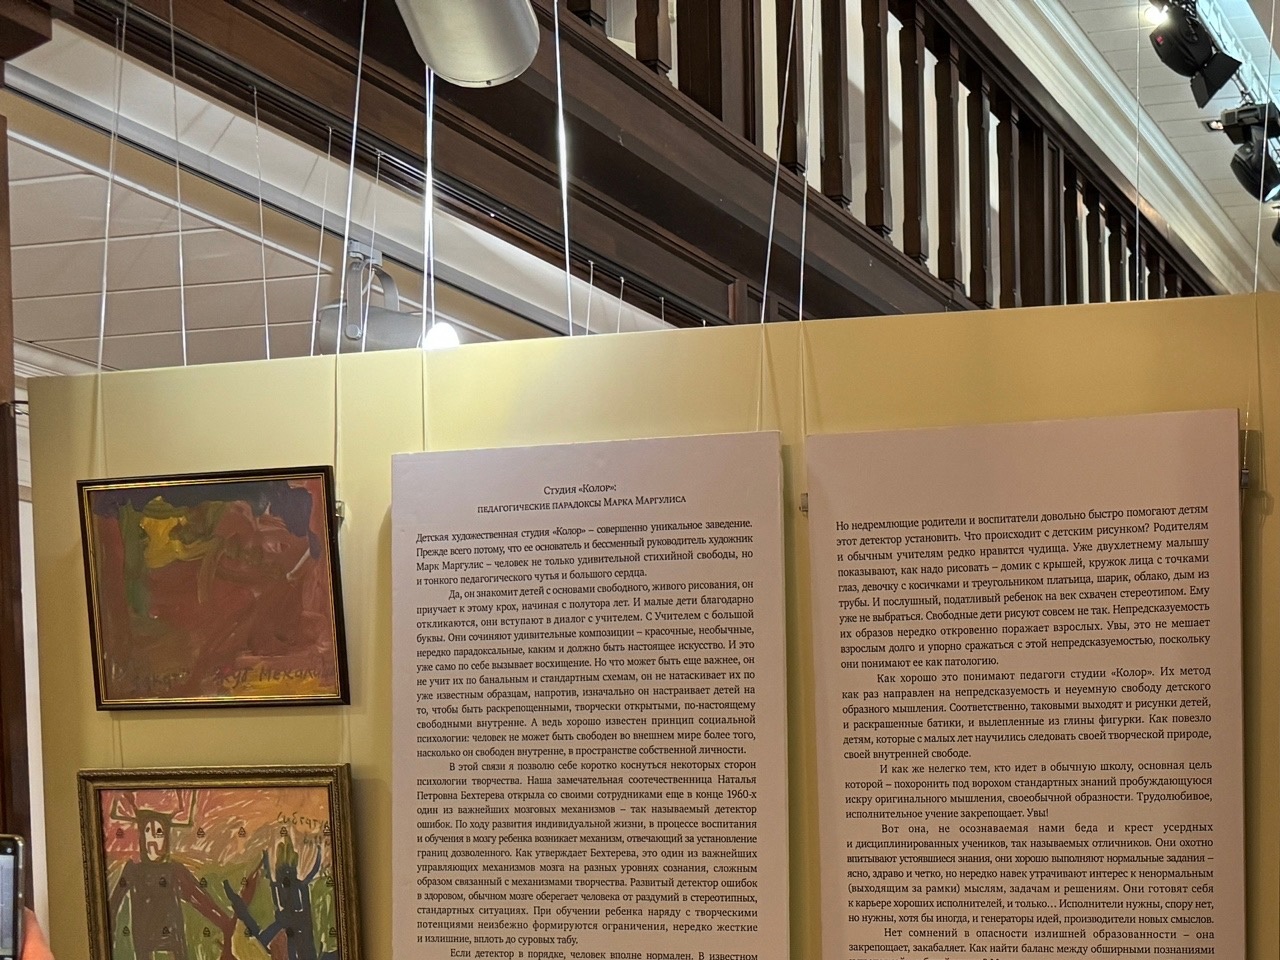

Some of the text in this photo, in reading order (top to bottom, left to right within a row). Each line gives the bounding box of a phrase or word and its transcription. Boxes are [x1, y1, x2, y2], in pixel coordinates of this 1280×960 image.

[835, 521, 850, 530] Но
[851, 520, 920, 532] недремлющие
[921, 518, 967, 529] родители
[977, 515, 1039, 524] воспитатели
[1040, 512, 1087, 523] довольно
[1088, 509, 1125, 520] быстро
[1126, 508, 1177, 517] помогают
[1177, 506, 1209, 516] детям
[415, 534, 449, 544] Детская
[451, 531, 519, 543] художественная
[520, 530, 550, 539] студия
[552, 527, 587, 537] «Колор»
[596, 525, 649, 535] совершенно
[650, 523, 703, 533] уникальное
[705, 521, 753, 529] заведение.
[836, 538, 858, 546] этот
[859, 537, 903, 546] детектор
[904, 534, 961, 545] установить.
[963, 531, 982, 540] Что
[984, 531, 1042, 542] происходит
[1051, 528, 1094, 538] детским
[1096, 523, 1150, 537] рисунком?
[1153, 522, 1209, 533] Родителям
[416, 548, 449, 559] Прежде
[473, 546, 506, 555] потому,
[534, 543, 583, 551] основатель
[591, 538, 645, 548] бессменный
[646, 537, 707, 549] руководитель
[708, 536, 754, 546] художник
[416, 558, 440, 573] Марк
[441, 561, 484, 572] Маргулис
[577, 552, 641, 566] удивительной
[643, 550, 694, 561] стихийной
[696, 549, 739, 560] свободы,
[423, 577, 459, 585] тонкого
[459, 574, 533, 584] педагогического
[533, 573, 560, 583] чутья
[569, 570, 613, 579] большого
[613, 570, 648, 579] сердца.
[876, 674, 896, 683] Как
[899, 675, 938, 685] хорошо
[963, 673, 1016, 681] понимают
[1019, 672, 1066, 680] педагоги
[1070, 671, 1107, 680] студии
[1110, 668, 1155, 679] «Колор».
[1160, 667, 1175, 676] Их
[1179, 668, 1212, 676] метод
[471, 778, 523, 787] творчества.
[527, 776, 553, 784] Наша
[628, 777, 713, 785] соотечественница
[717, 775, 757, 784] Наталья
[416, 791, 458, 802] Петровна
[460, 791, 505, 802] Бехтерева
[507, 792, 545, 801] открыла
[596, 792, 663, 801] сотрудниками
[726, 789, 757, 798] 1960-х
[881, 824, 900, 833] Вот
[907, 826, 929, 834] она,
[1074, 823, 1098, 834] беда
[1124, 825, 1154, 834] крест
[1162, 824, 1214, 834] усердных
